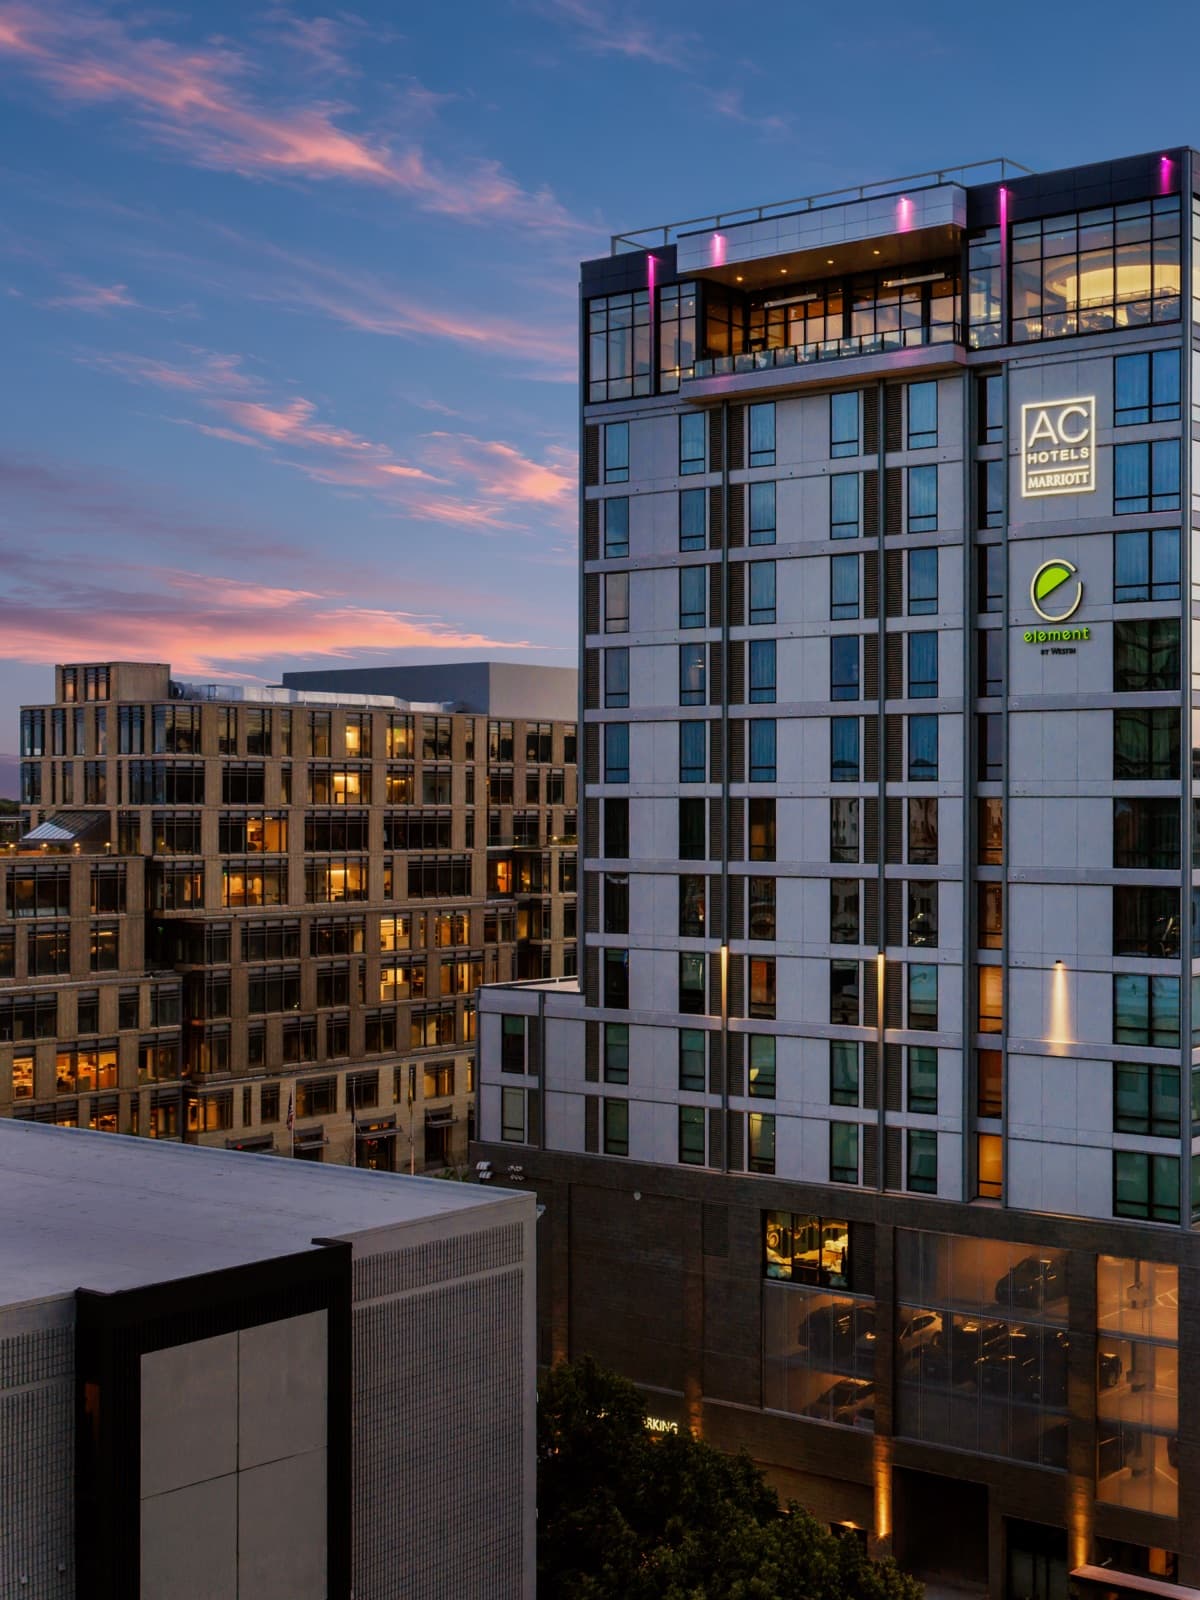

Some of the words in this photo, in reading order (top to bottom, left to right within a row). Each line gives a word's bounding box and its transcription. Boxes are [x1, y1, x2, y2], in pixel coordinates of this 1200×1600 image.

[1028, 406, 1088, 447] AC
[1027, 447, 1089, 464] HOTELS
[1028, 471, 1089, 489] MARRIOTT
[1024, 627, 1088, 643] element
